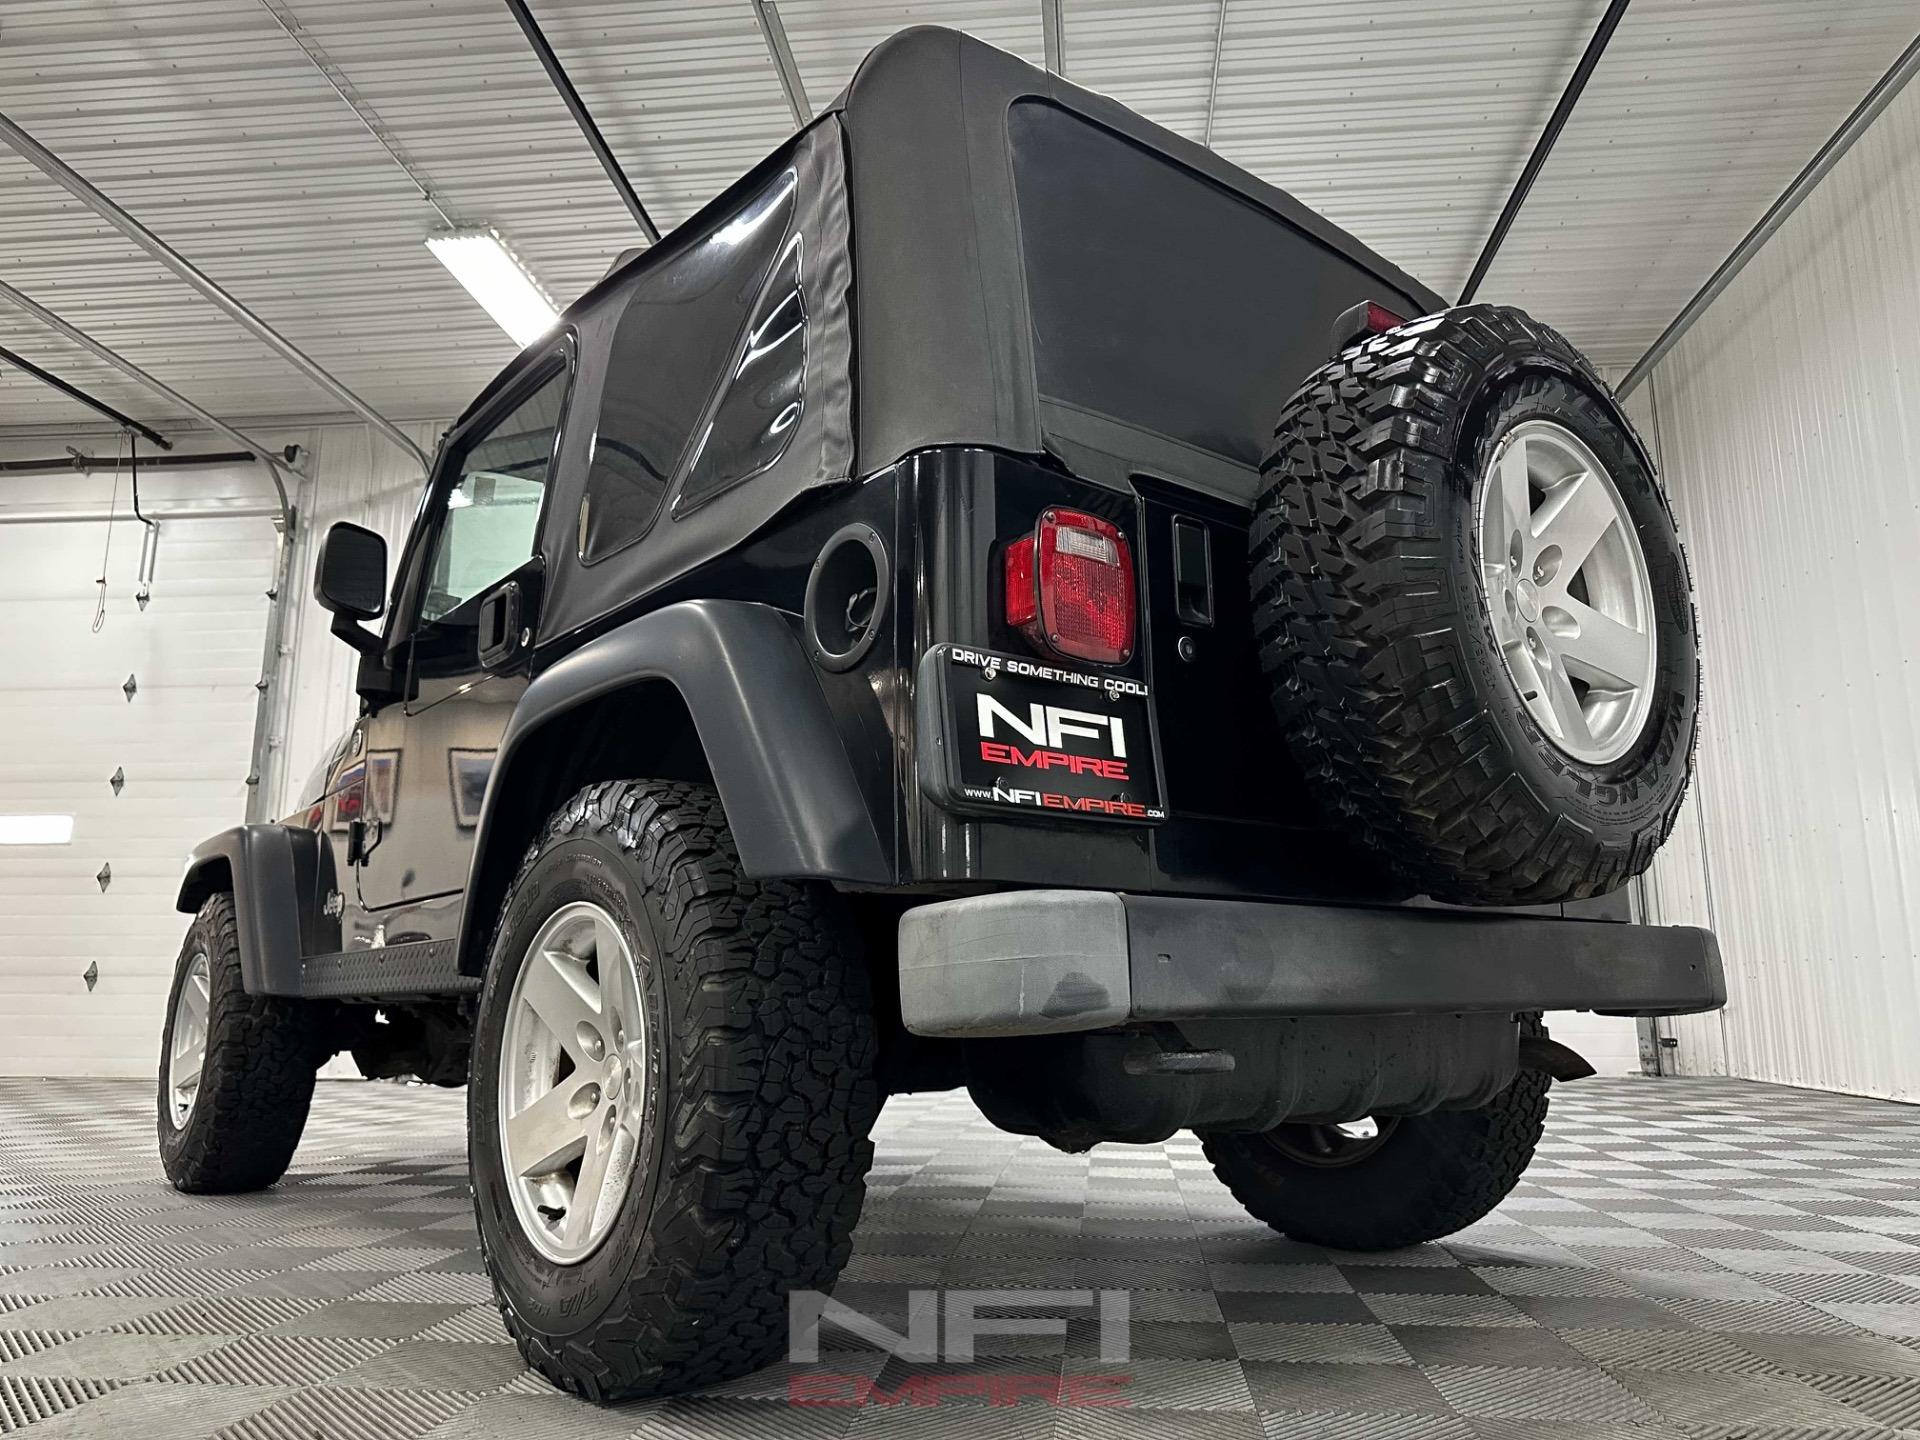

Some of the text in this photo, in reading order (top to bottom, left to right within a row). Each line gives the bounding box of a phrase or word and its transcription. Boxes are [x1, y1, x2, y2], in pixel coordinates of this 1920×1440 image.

[952, 648, 1149, 696] DRIVE SOMETHING COOL!
[976, 693, 1127, 758] NFI
[1516, 690, 1686, 805] WRANGLER
[980, 741, 1130, 780] EMPIRE
